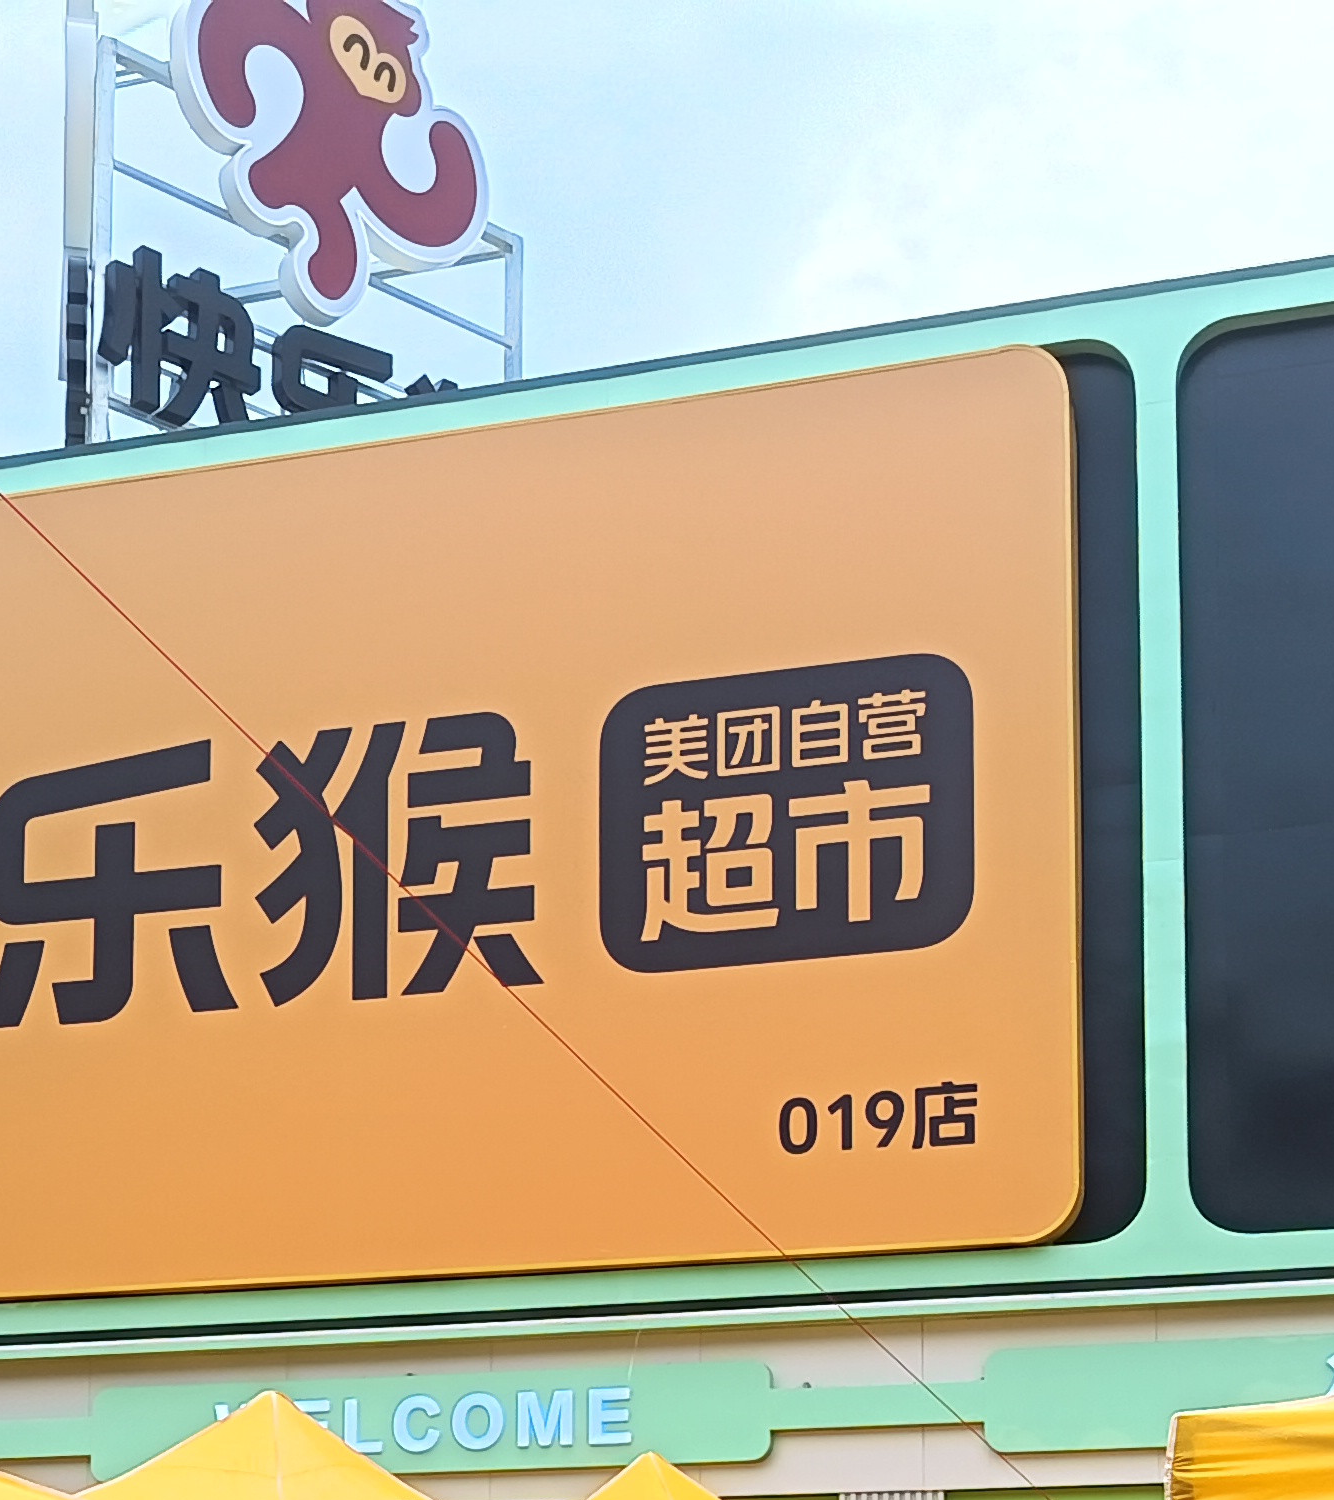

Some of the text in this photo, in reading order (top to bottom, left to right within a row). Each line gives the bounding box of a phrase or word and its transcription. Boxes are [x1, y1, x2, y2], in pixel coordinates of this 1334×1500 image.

[98, 245, 458, 426] 快乐
[642, 689, 928, 786] 美团自营
[640, 780, 932, 942] 超市
[777, 1081, 980, 1156] 019店
[214, 1386, 633, 1454] LCOME
